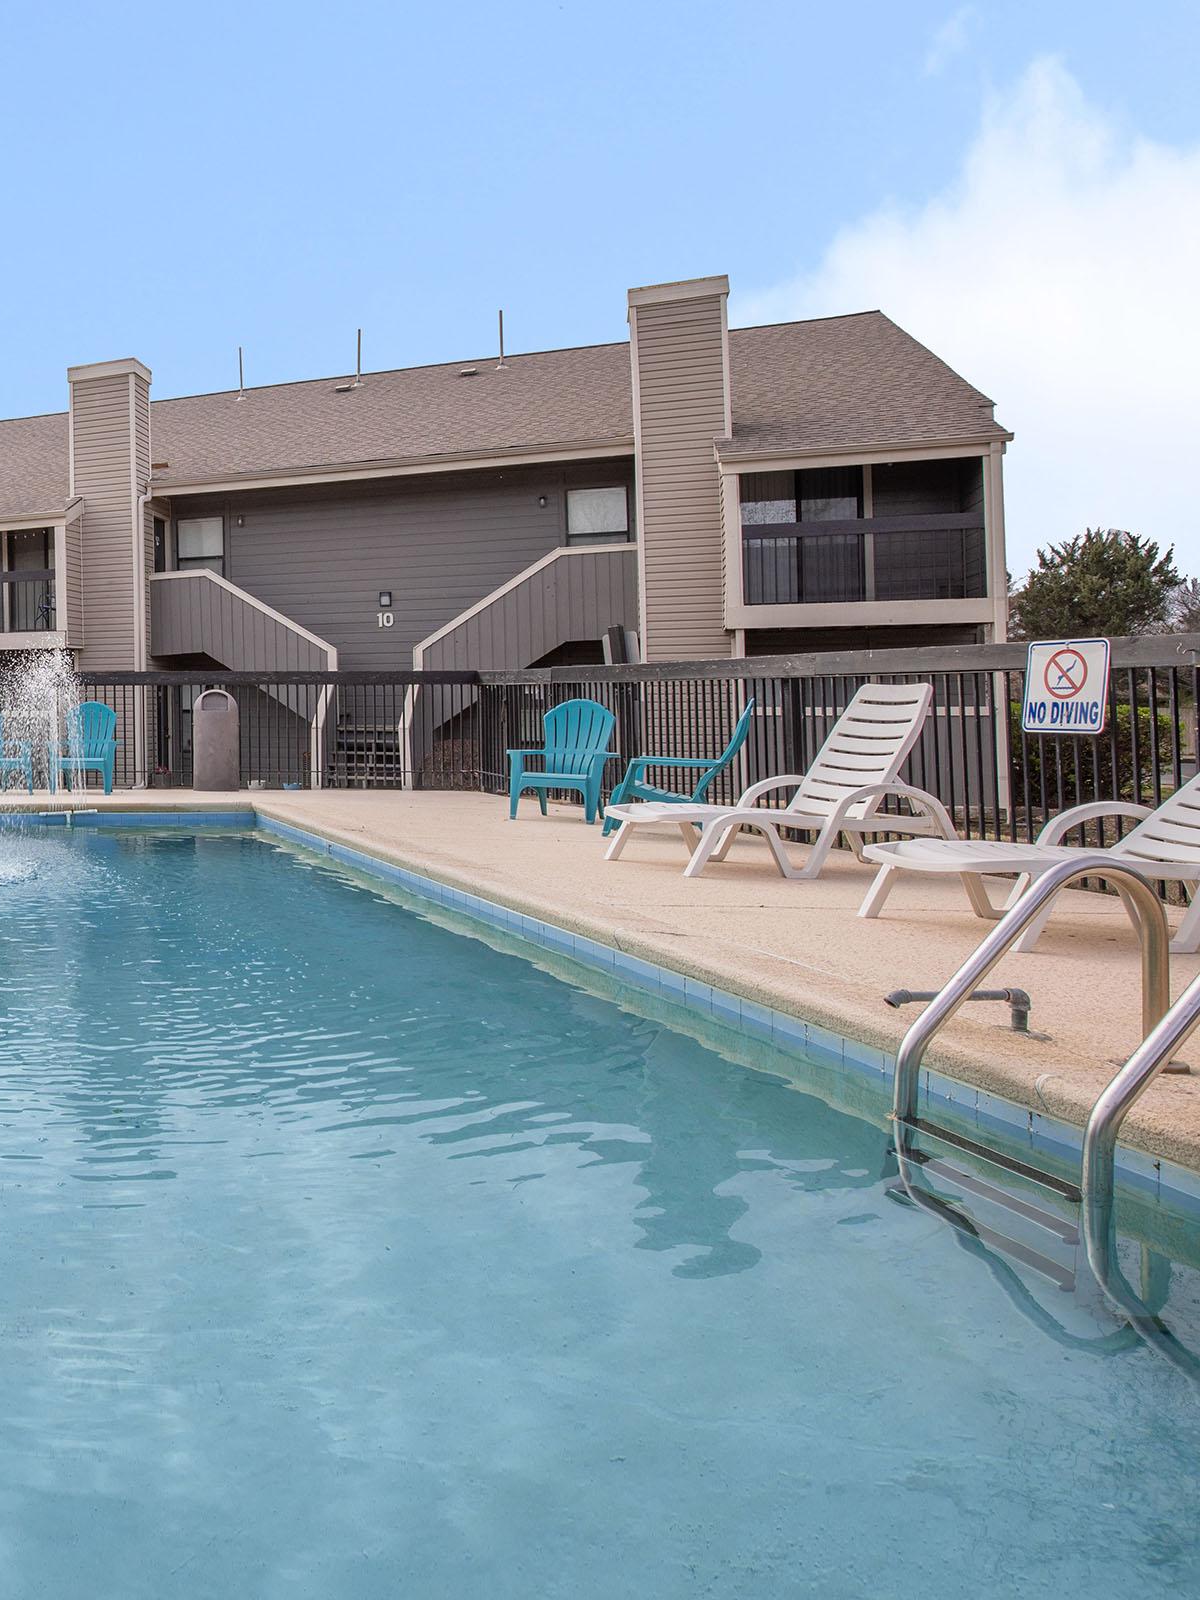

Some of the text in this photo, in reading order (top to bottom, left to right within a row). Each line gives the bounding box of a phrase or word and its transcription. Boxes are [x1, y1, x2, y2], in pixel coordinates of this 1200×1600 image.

[377, 612, 394, 628] 10
[1027, 701, 1099, 724] NO DIVING
